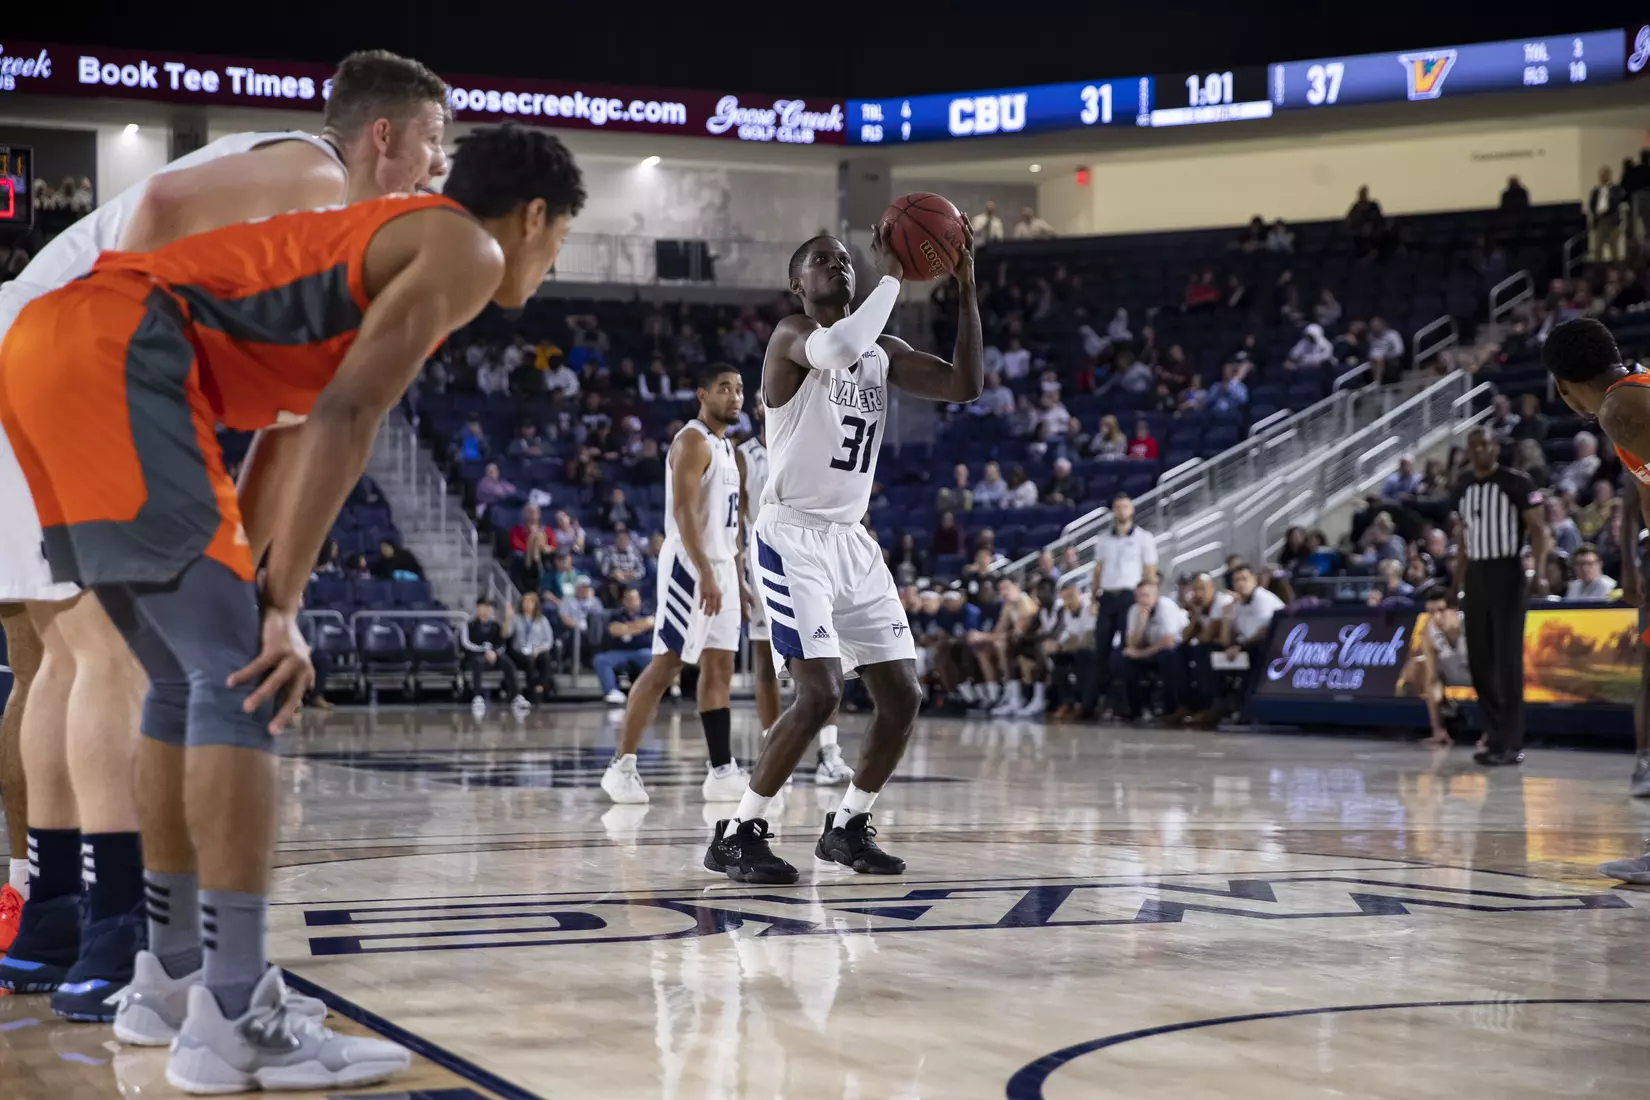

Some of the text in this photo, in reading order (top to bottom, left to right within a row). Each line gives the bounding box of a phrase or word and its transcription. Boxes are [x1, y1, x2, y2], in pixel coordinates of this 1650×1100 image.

[0, 44, 52, 79] reek
[78, 55, 158, 90] Book
[164, 61, 219, 93] Tee
[226, 66, 315, 100] Times
[1080, 83, 1112, 125] 31
[1185, 71, 1234, 107] 1:01
[1306, 62, 1345, 106] 37
[450, 87, 687, 126] oosecreekgc.com
[706, 95, 843, 134] Goose Creek
[948, 93, 1027, 136] CBU
[738, 125, 814, 144] GOLF CLUB
[830, 414, 878, 474] 31
[1267, 622, 1405, 680] Goose Creek
[1292, 668, 1365, 690] GOLF CLUB
